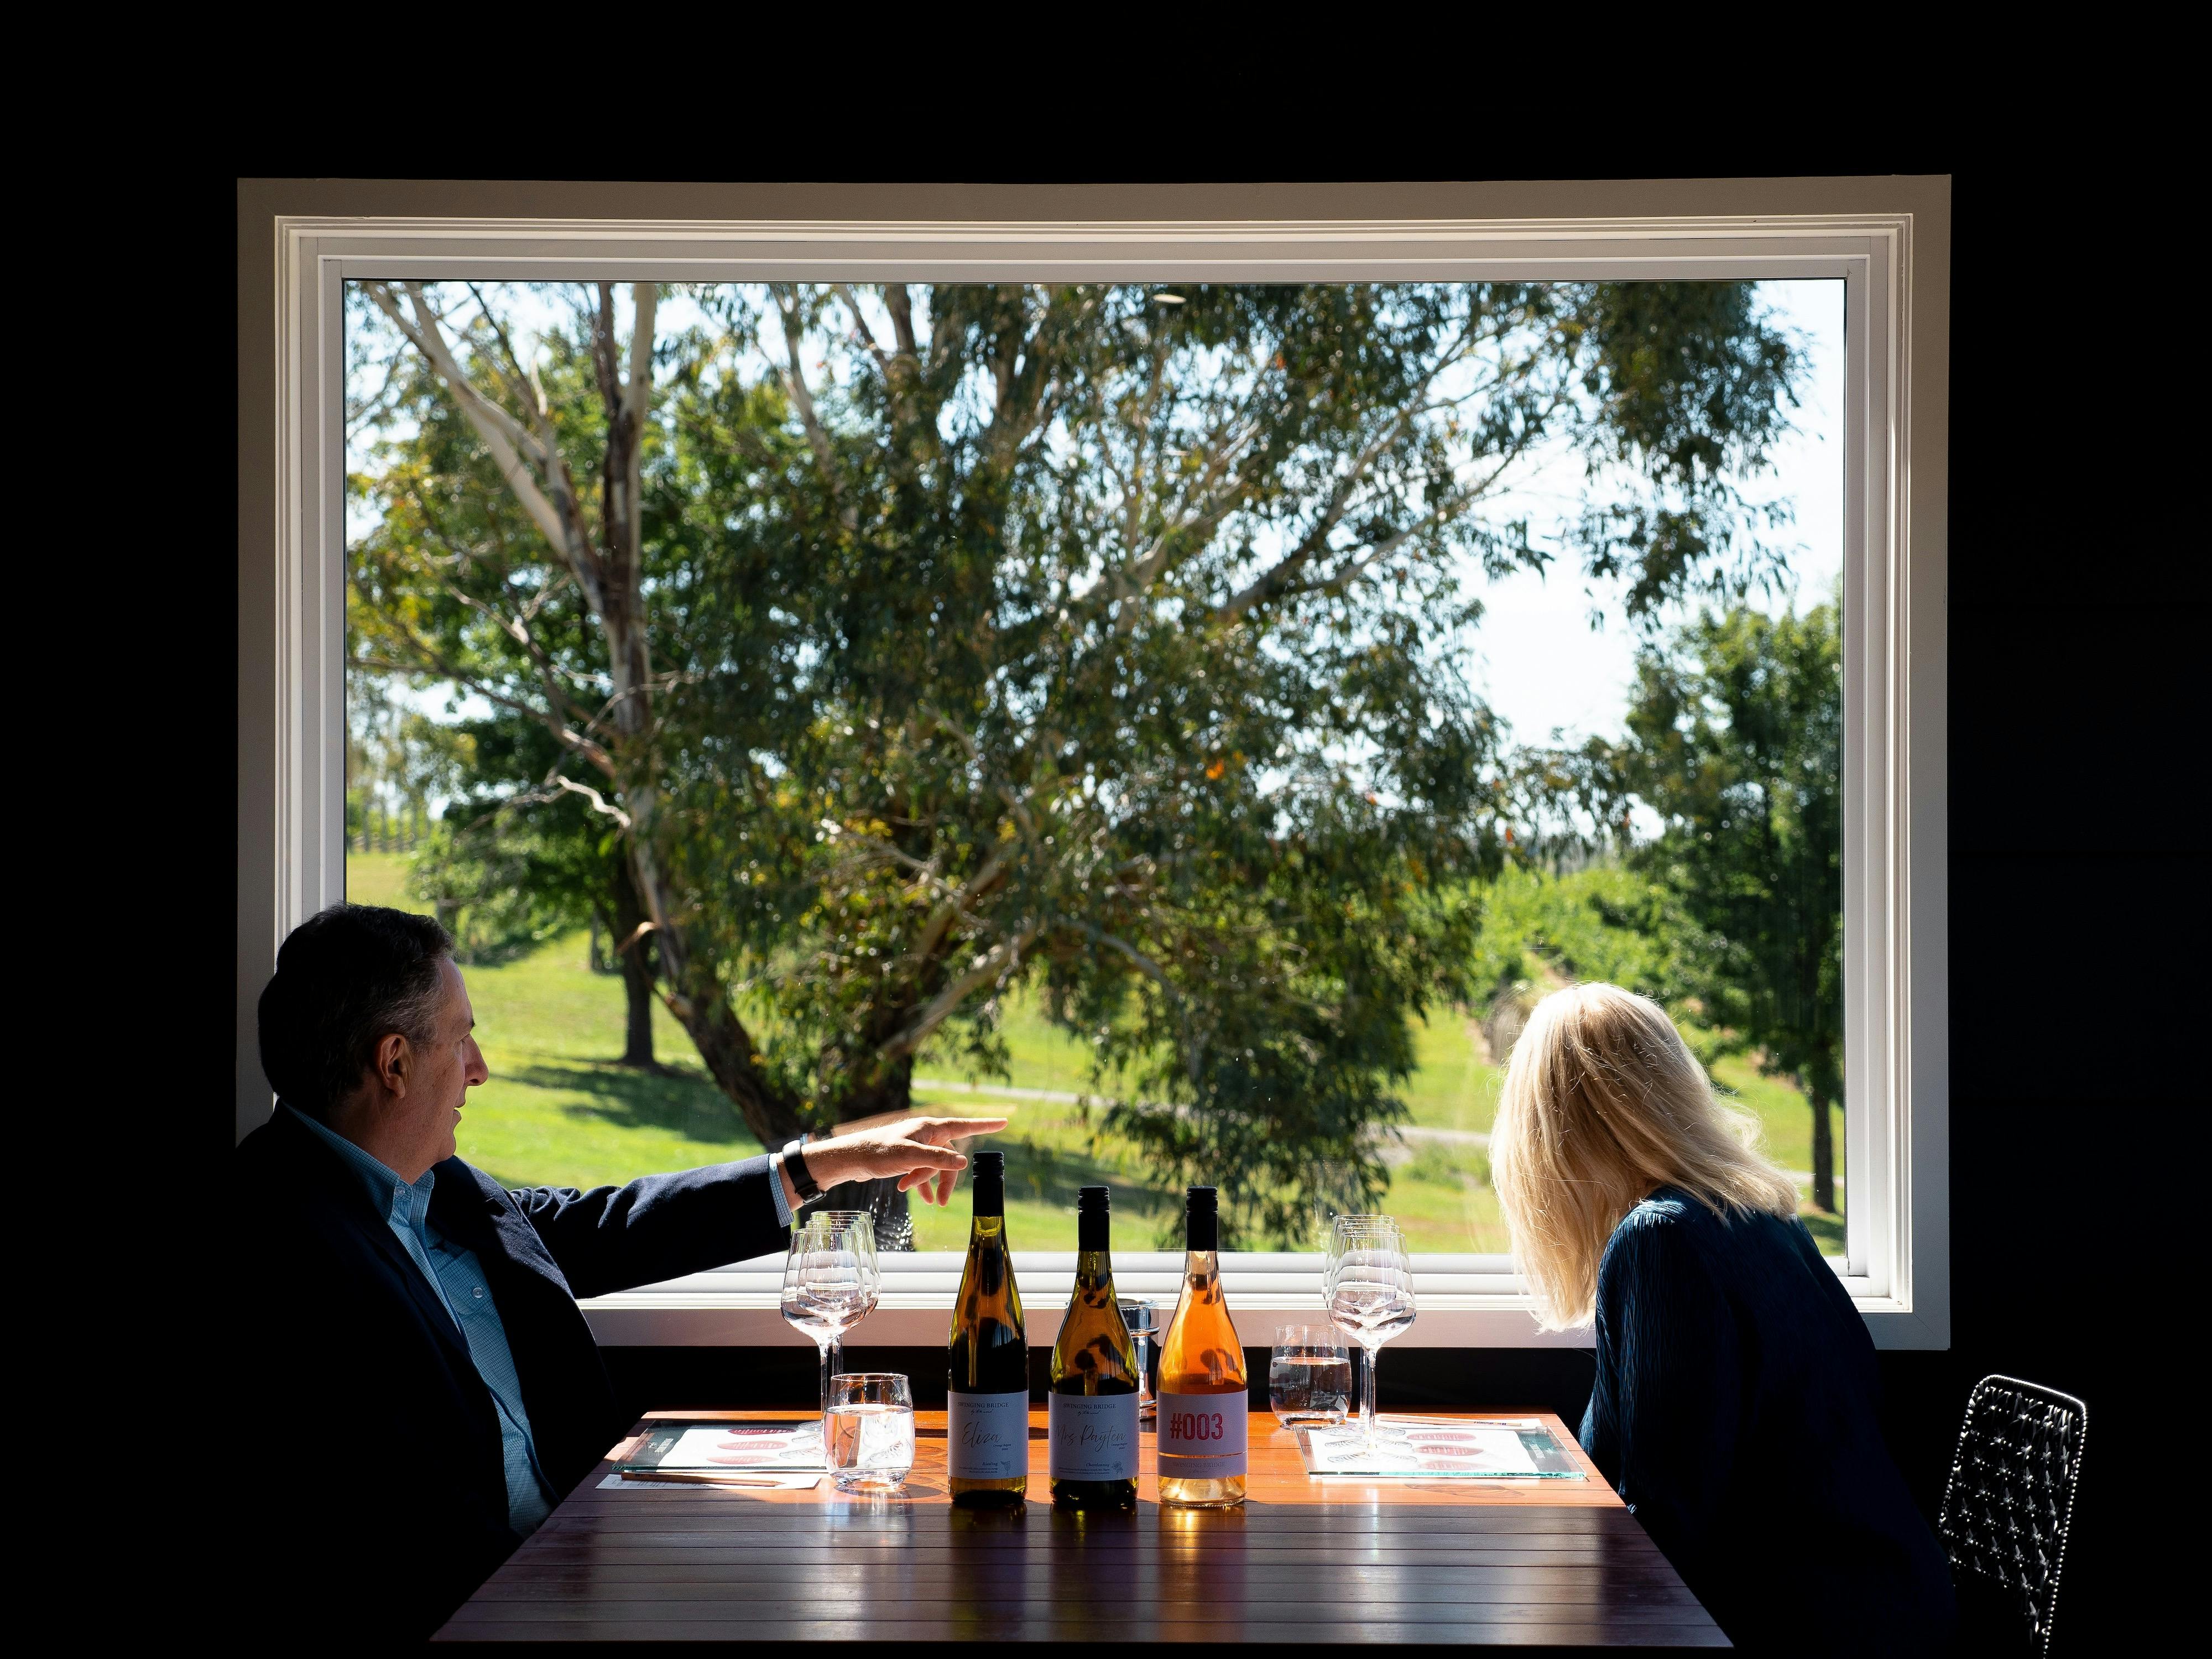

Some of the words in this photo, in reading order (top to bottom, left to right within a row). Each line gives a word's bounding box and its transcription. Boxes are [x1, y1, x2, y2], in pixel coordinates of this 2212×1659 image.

[961, 1421, 1003, 1448] Eliza
[1054, 1424, 1076, 1446] Mrs
[1081, 1425, 1126, 1452] Payten
[1170, 1413, 1223, 1440] #003
